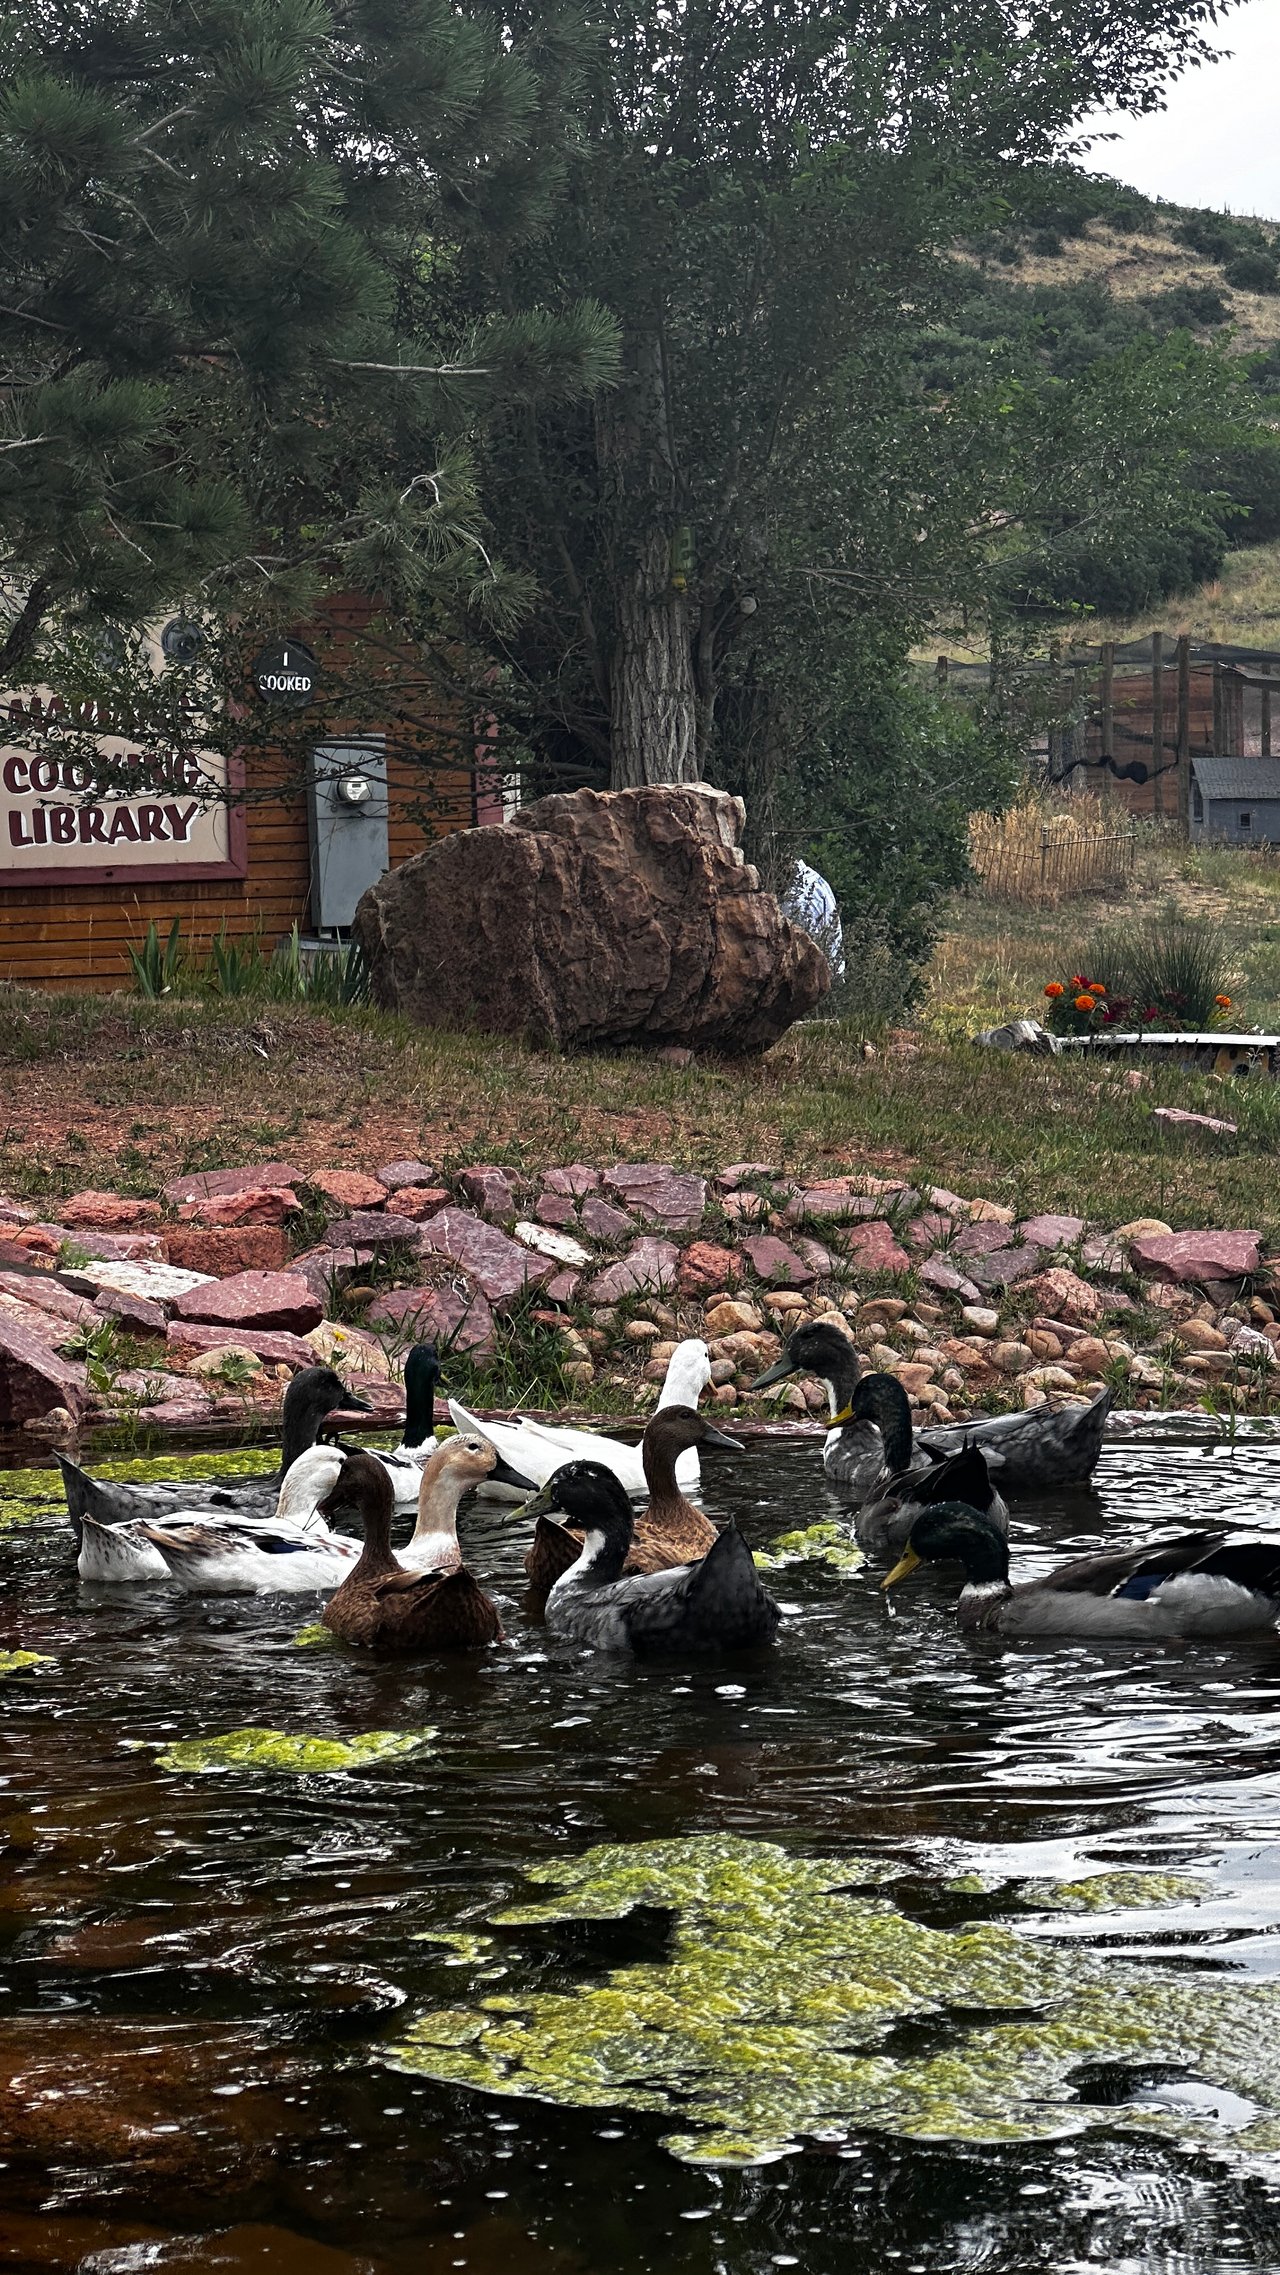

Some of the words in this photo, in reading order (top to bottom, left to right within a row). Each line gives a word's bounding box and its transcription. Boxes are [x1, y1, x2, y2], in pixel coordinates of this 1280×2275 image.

[283, 651, 289, 667] I
[258, 674, 312, 692] COOKED
[8, 802, 200, 848] LIBRARY
